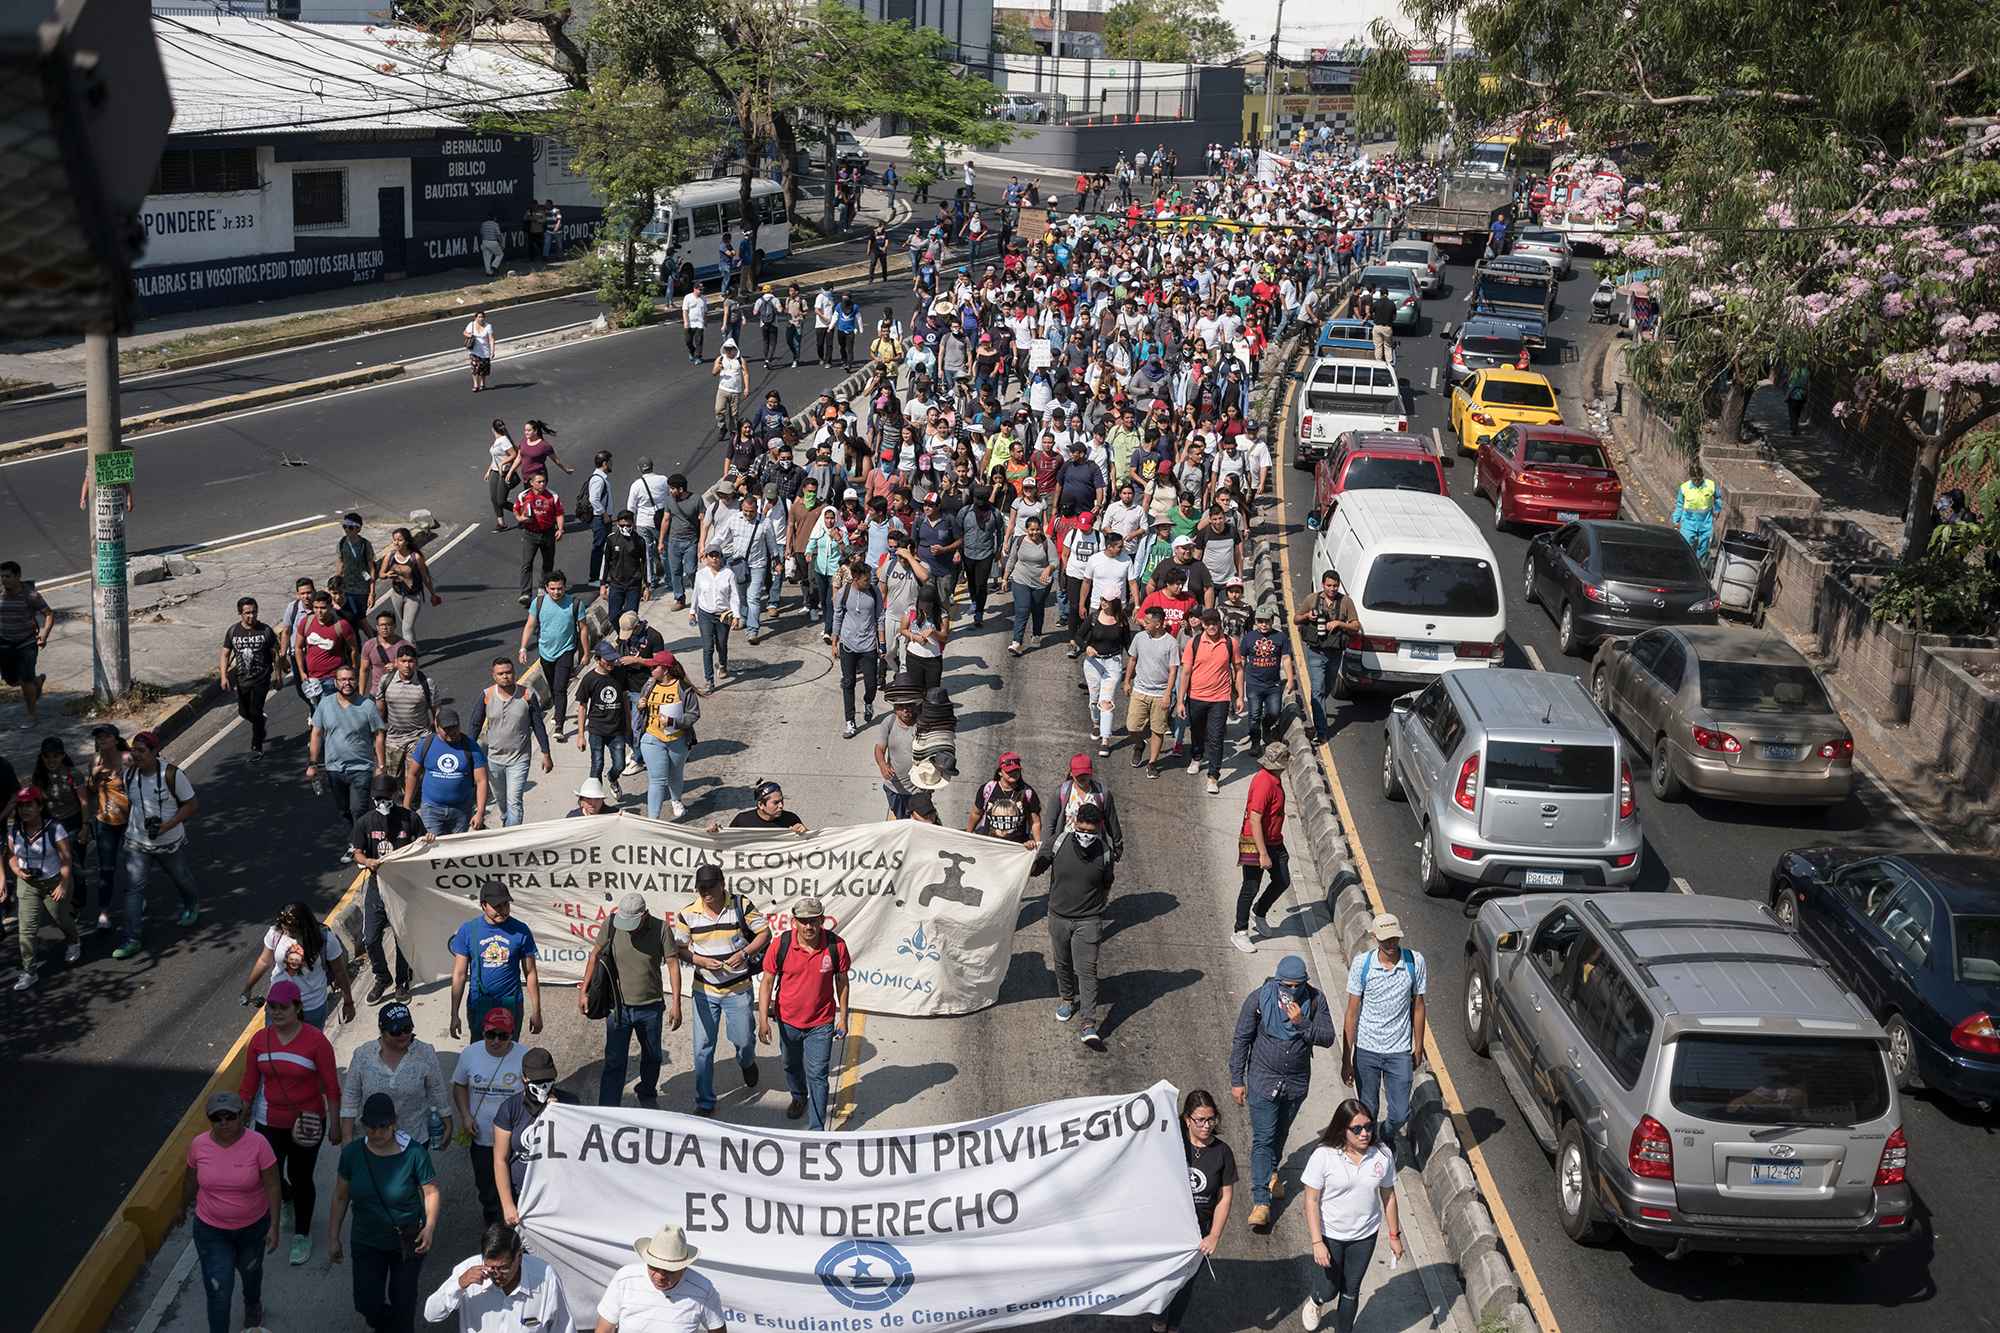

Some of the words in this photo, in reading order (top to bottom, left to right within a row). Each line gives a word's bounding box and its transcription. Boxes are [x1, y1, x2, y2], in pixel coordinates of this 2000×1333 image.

[448, 160, 486, 177] BIBLICO
[424, 182, 469, 199] BAUTISTA
[138, 208, 223, 236] PONDERE"
[190, 270, 203, 290] EN
[260, 261, 287, 282] PEDID
[289, 257, 313, 277] TODO
[313, 256, 320, 274] Y
[320, 256, 333, 274] OS
[333, 253, 356, 272] SERA
[357, 250, 384, 269] HECHO
[430, 850, 560, 870] FACULTAD
[570, 847, 601, 865] DE
[611, 844, 726, 869] CIENCIAS
[734, 846, 904, 870] ECONÓMICAS
[435, 871, 542, 889] CONTRA
[549, 871, 580, 889] LA
[783, 876, 823, 897] DEL
[831, 876, 897, 898] AGUA
[848, 968, 933, 994] ONÓMICAS
[533, 1119, 567, 1161] EL
[578, 1124, 705, 1169] AGUA
[720, 1137, 785, 1177] NO
[799, 1141, 843, 1182] ES
[857, 1135, 917, 1177] UN
[932, 1092, 1169, 1173] PRIVILEGIO,
[685, 1192, 729, 1232] ES
[745, 1196, 804, 1237] UN
[820, 1188, 1019, 1238] DERECHO
[724, 1307, 747, 1324] de
[754, 1313, 873, 1332] Estudiantes
[880, 1311, 904, 1328] de
[911, 1306, 1000, 1326] Ciencias
